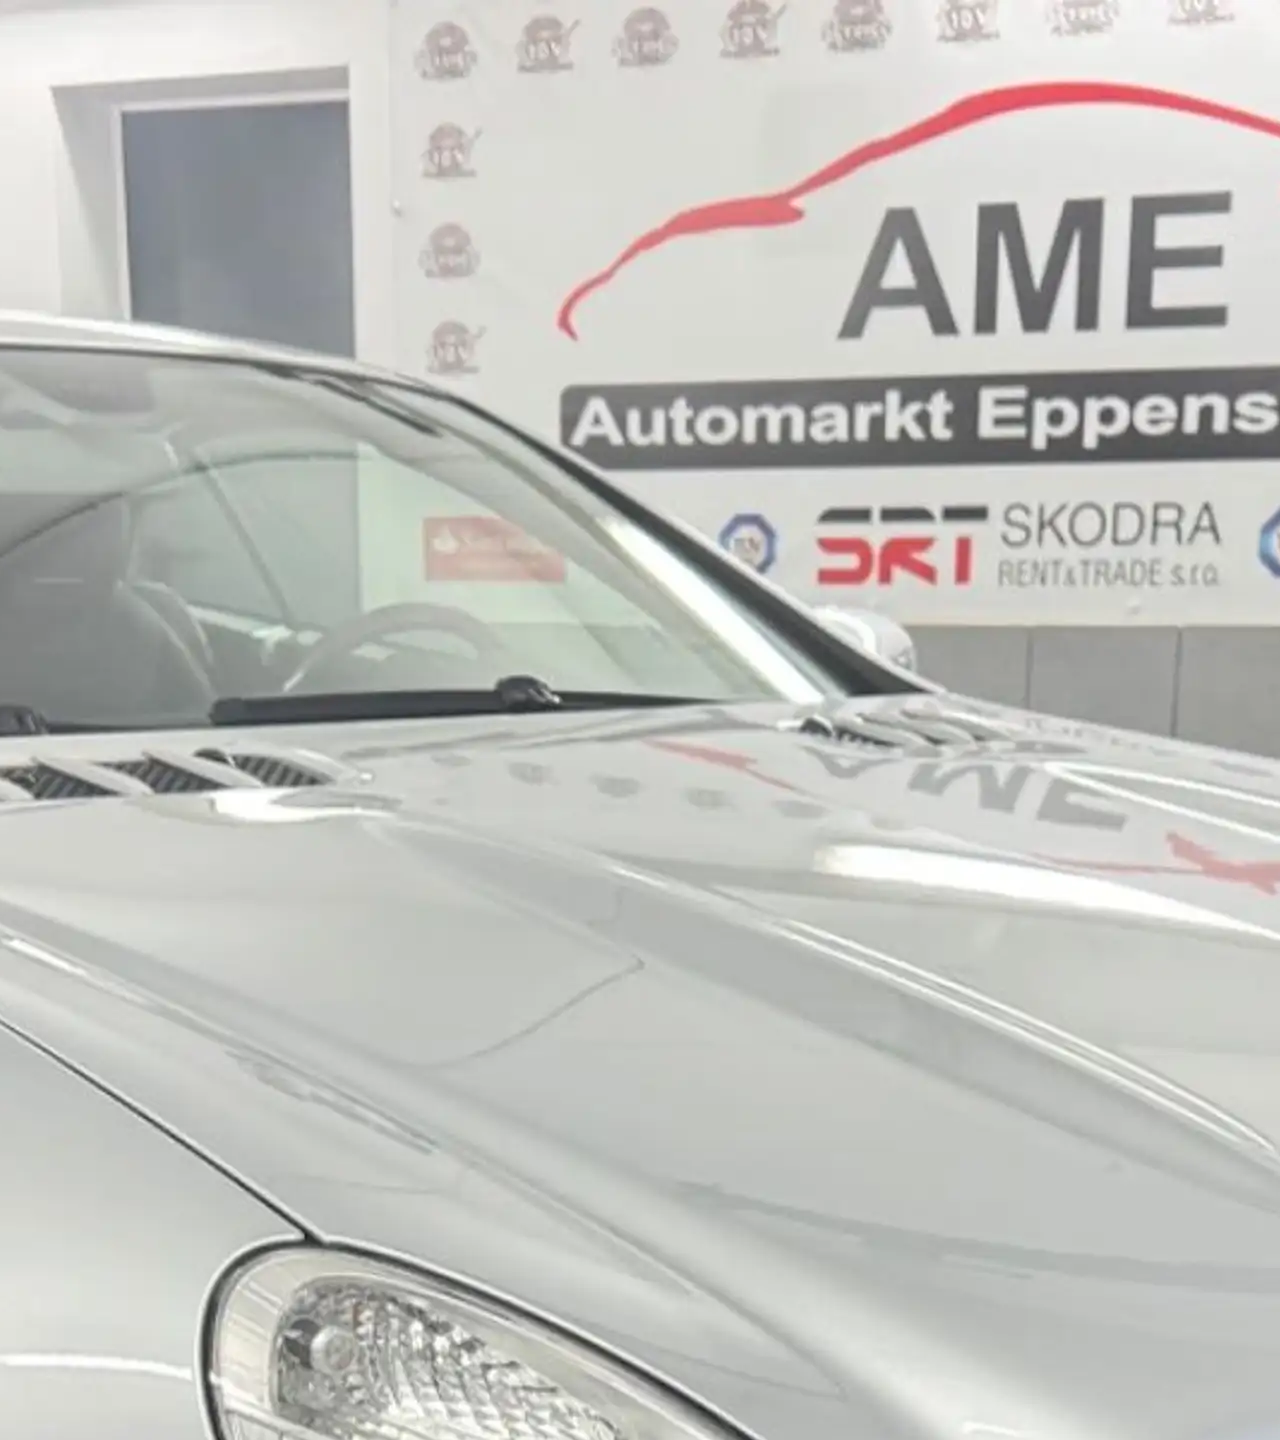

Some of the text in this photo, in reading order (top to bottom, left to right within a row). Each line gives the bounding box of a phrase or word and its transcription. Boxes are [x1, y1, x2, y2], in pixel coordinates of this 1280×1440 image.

[837, 190, 1232, 340] AME
[569, 389, 954, 446] Automarkt
[816, 505, 989, 586] SRT
[1000, 501, 1223, 548] SKODRA
